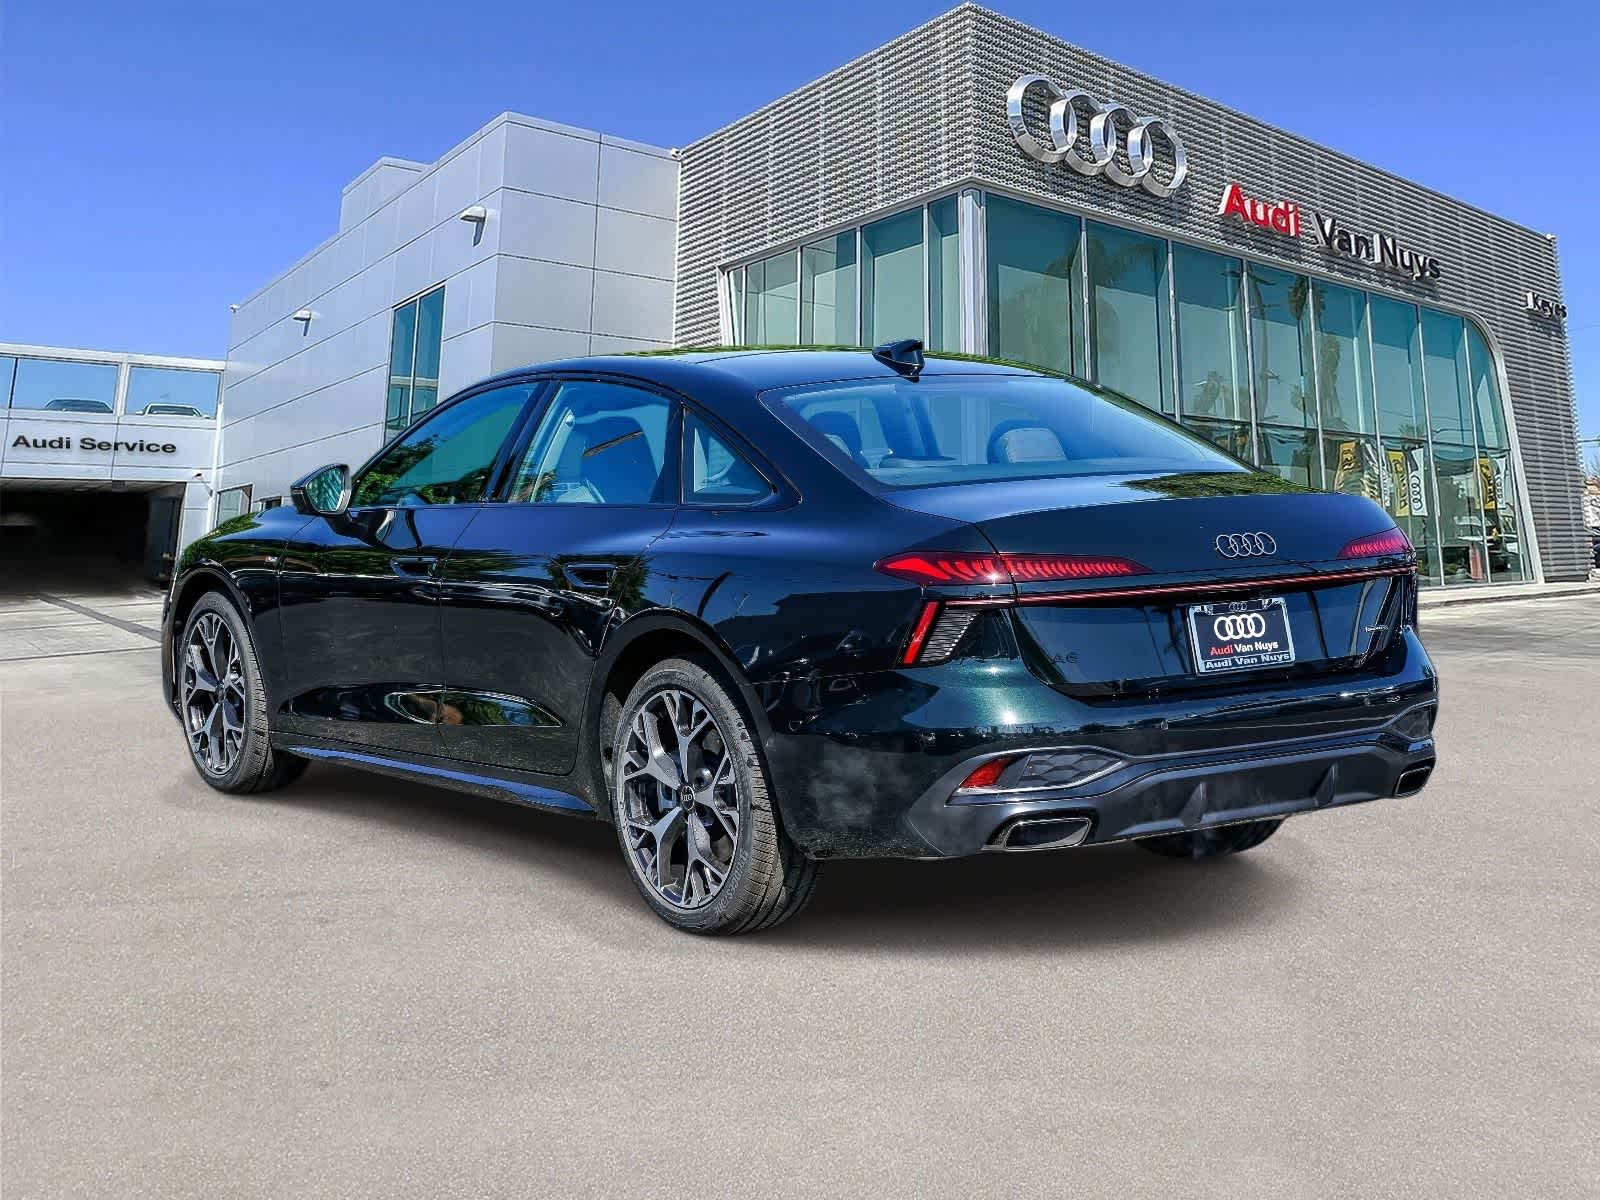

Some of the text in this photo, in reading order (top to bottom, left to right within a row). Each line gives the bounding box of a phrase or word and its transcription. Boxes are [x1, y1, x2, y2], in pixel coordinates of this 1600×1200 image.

[1220, 182, 1441, 280] Audi Van Nuys
[12, 434, 177, 453] Audi Service
[1210, 641, 1279, 656] Audi Van Nuys
[1206, 653, 1290, 669] Audi Van Nuys
